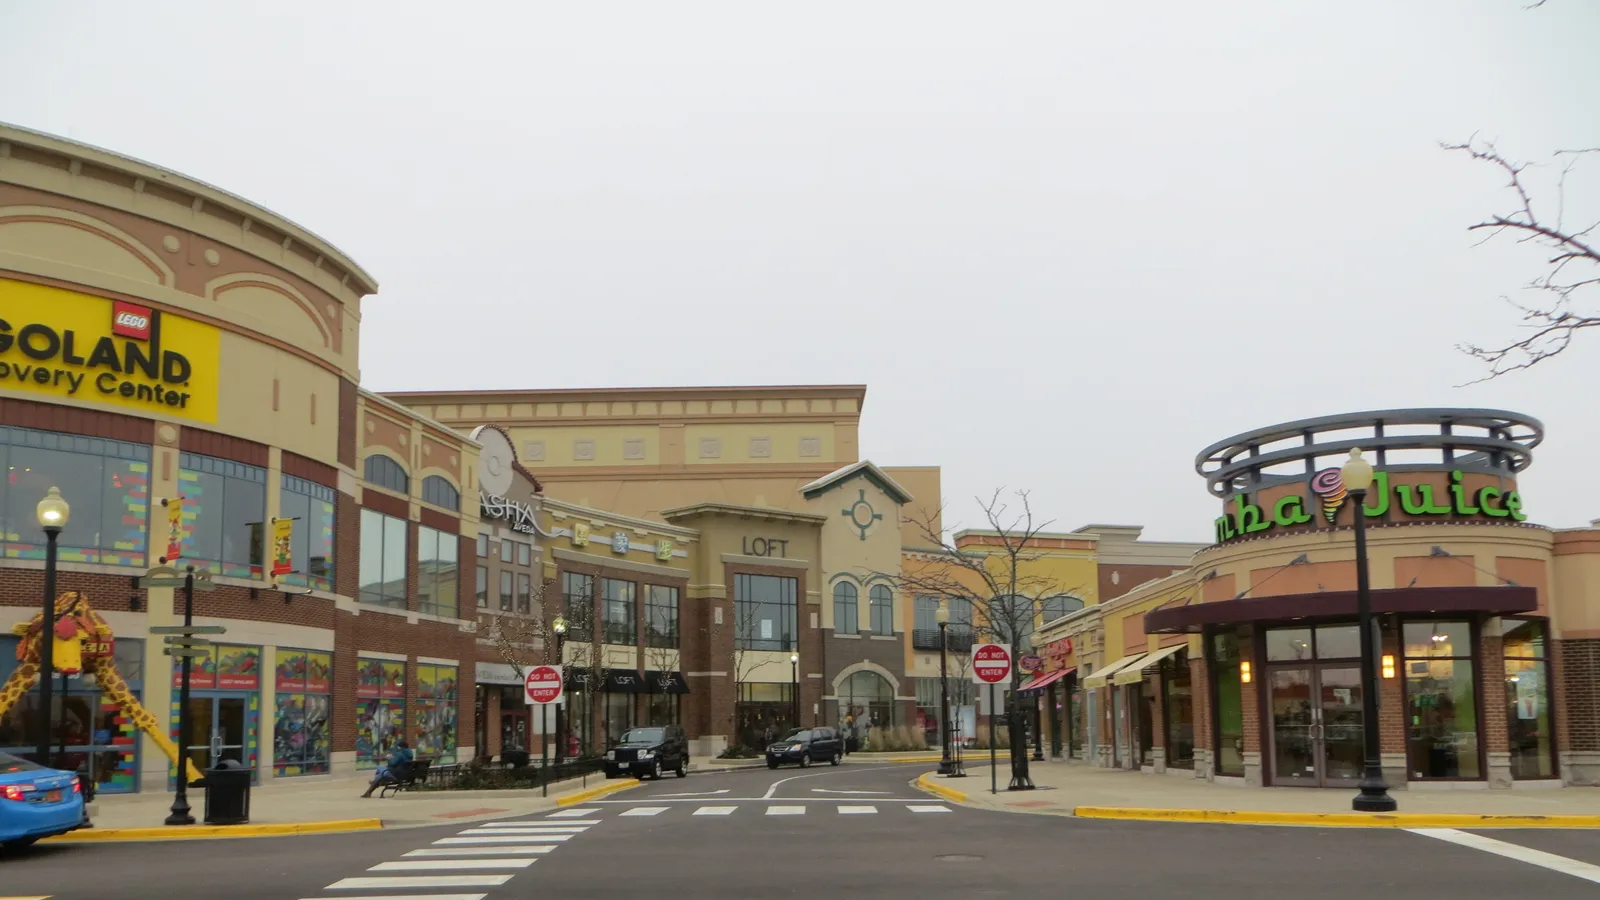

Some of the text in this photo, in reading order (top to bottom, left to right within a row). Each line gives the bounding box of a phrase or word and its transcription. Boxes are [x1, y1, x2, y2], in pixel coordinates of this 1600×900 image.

[117, 312, 148, 330] LEGO
[96, 373, 191, 408] Center
[1361, 470, 1527, 521] Juice
[513, 523, 535, 535] AVEDA
[742, 535, 789, 558] LOFT
[614, 676, 635, 685] LOFT
